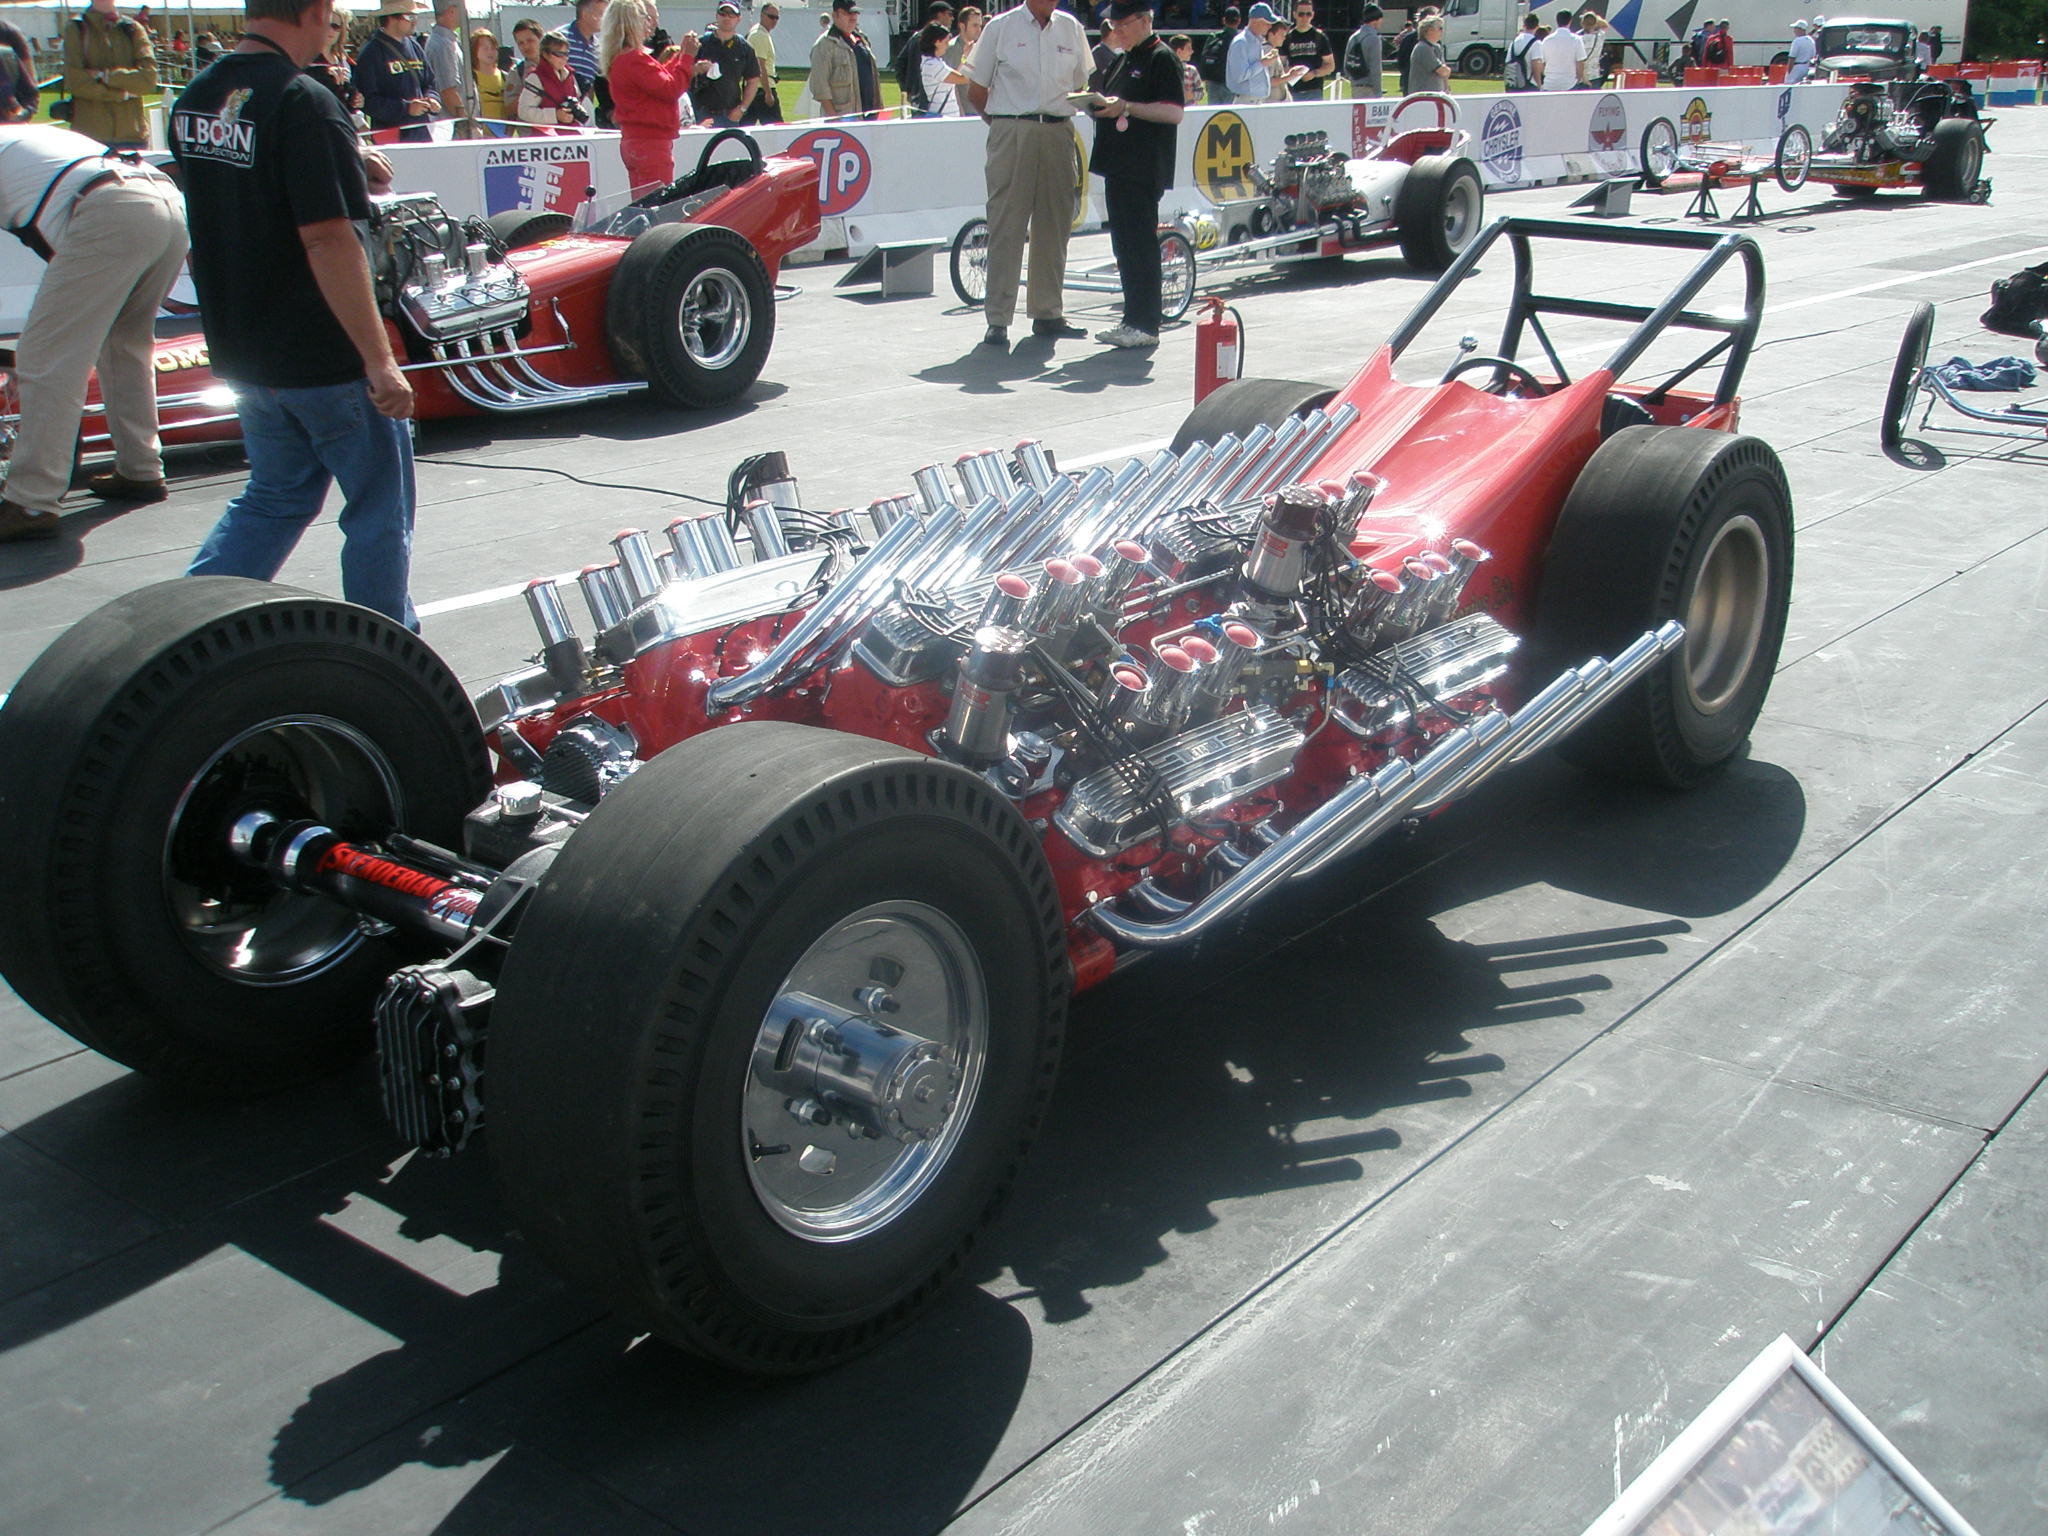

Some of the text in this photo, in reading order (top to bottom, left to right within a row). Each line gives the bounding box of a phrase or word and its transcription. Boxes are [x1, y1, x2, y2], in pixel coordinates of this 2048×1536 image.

[1372, 105, 1390, 117] B&M
[486, 145, 589, 165] AMERICAN
[1207, 123, 1242, 160] M
[1484, 130, 1520, 158] CHRYSLER
[800, 138, 861, 203] TP
[1207, 165, 1247, 200] H
